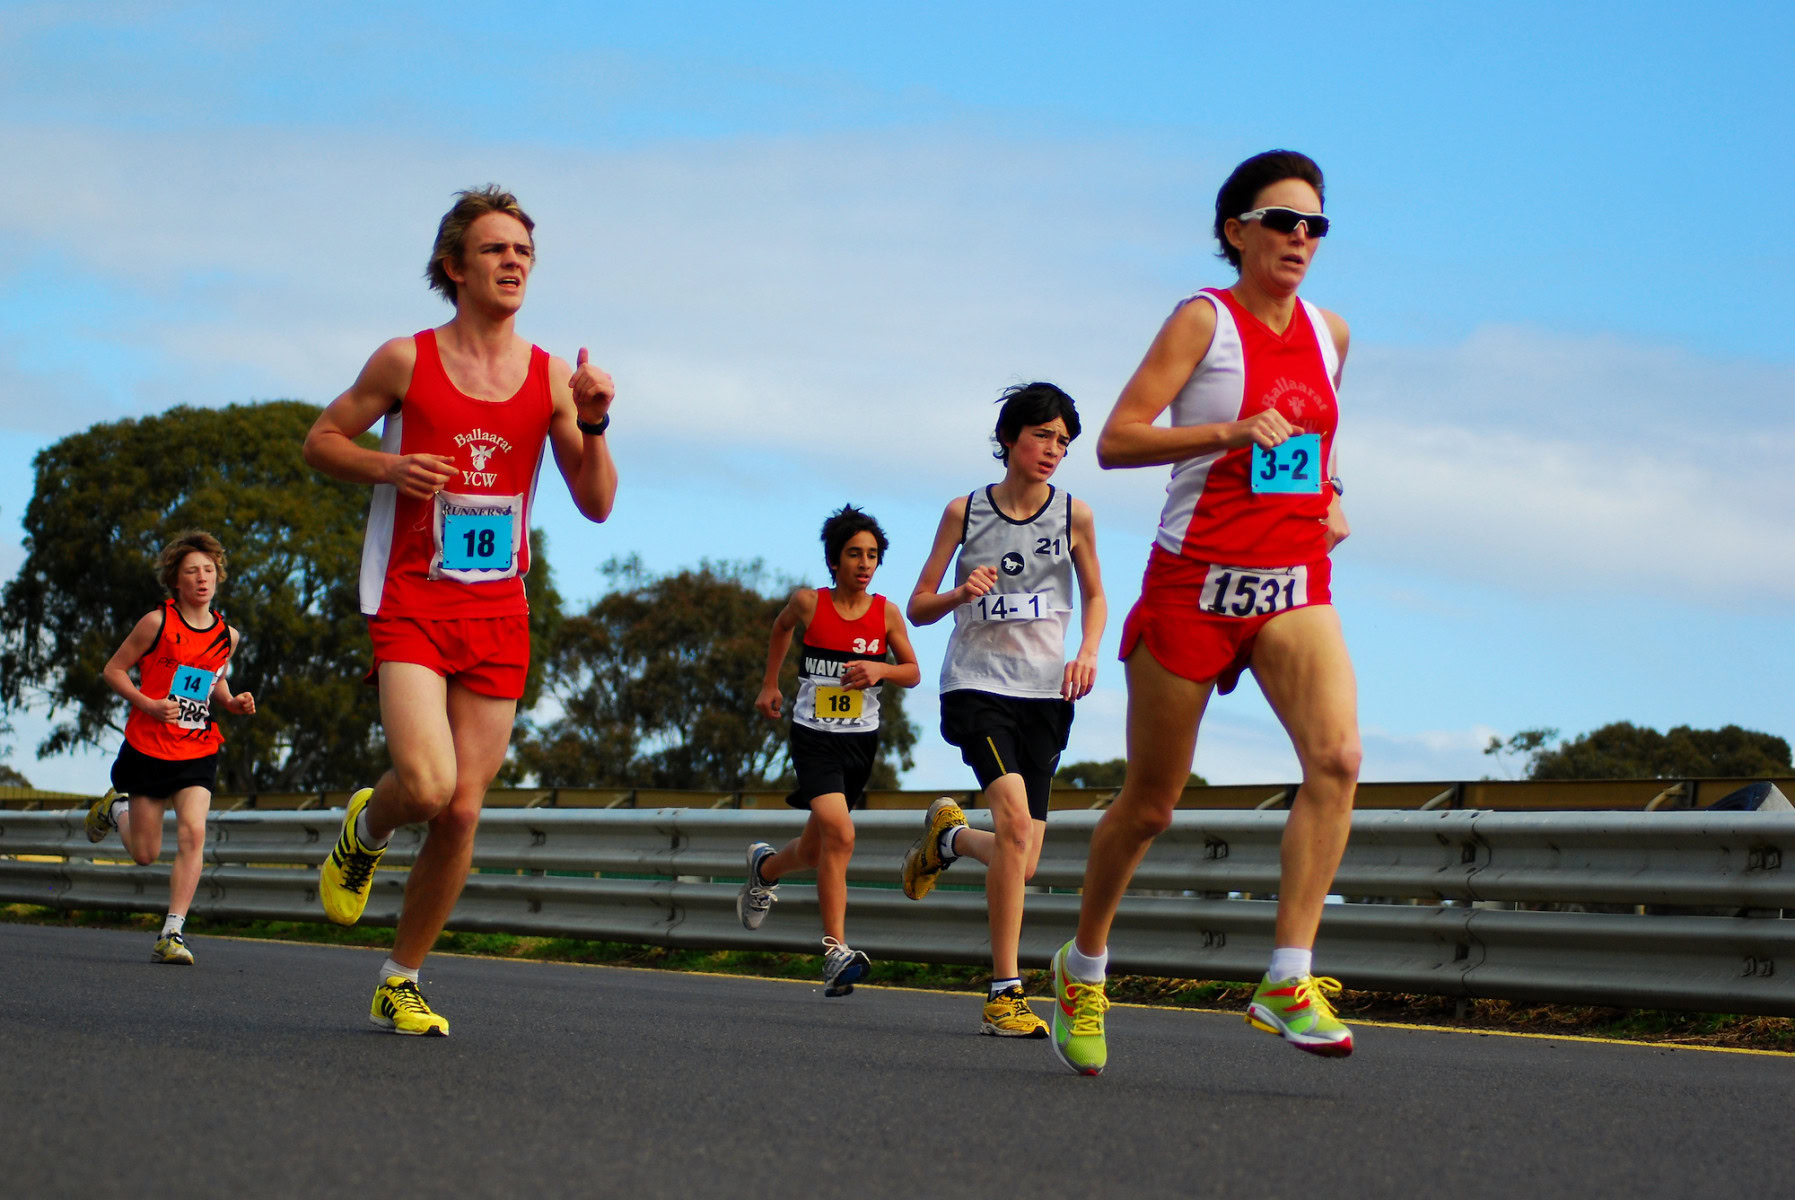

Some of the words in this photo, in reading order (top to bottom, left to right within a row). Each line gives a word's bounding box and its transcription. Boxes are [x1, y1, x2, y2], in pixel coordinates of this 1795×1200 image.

[453, 428, 513, 454] Ballaarat
[1260, 449, 1309, 480] 3-2
[462, 470, 498, 488] YCW
[463, 529, 495, 558] 18
[1035, 537, 1060, 556] 21
[1208, 572, 1296, 617] 1531
[852, 637, 880, 654] 34
[184, 675, 202, 693] 14
[828, 694, 851, 712] 18
